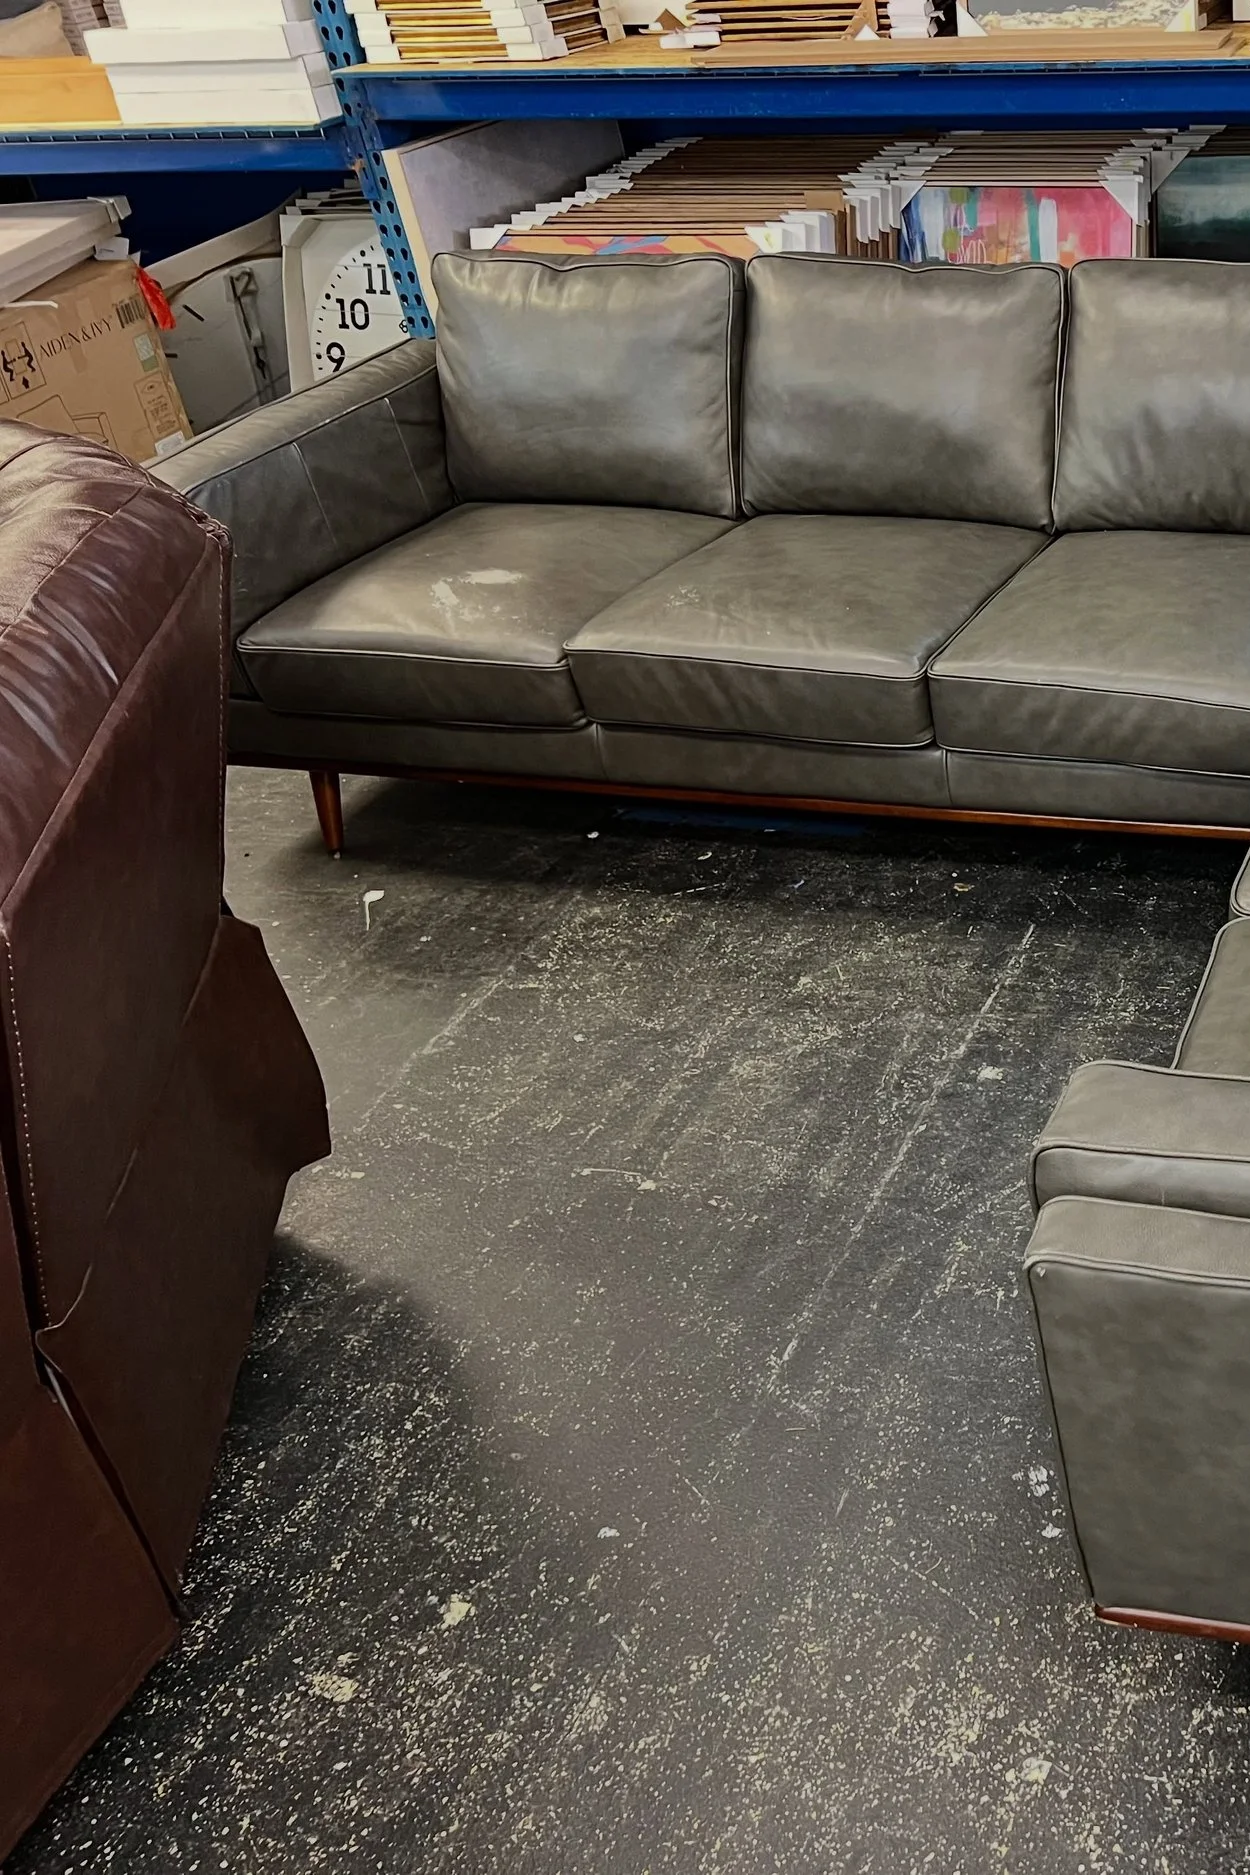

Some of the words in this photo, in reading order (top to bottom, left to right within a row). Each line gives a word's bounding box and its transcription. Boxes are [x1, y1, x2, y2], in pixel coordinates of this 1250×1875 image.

[363, 263, 391, 295] 11
[335, 298, 370, 330] 10
[326, 342, 346, 373] 9
